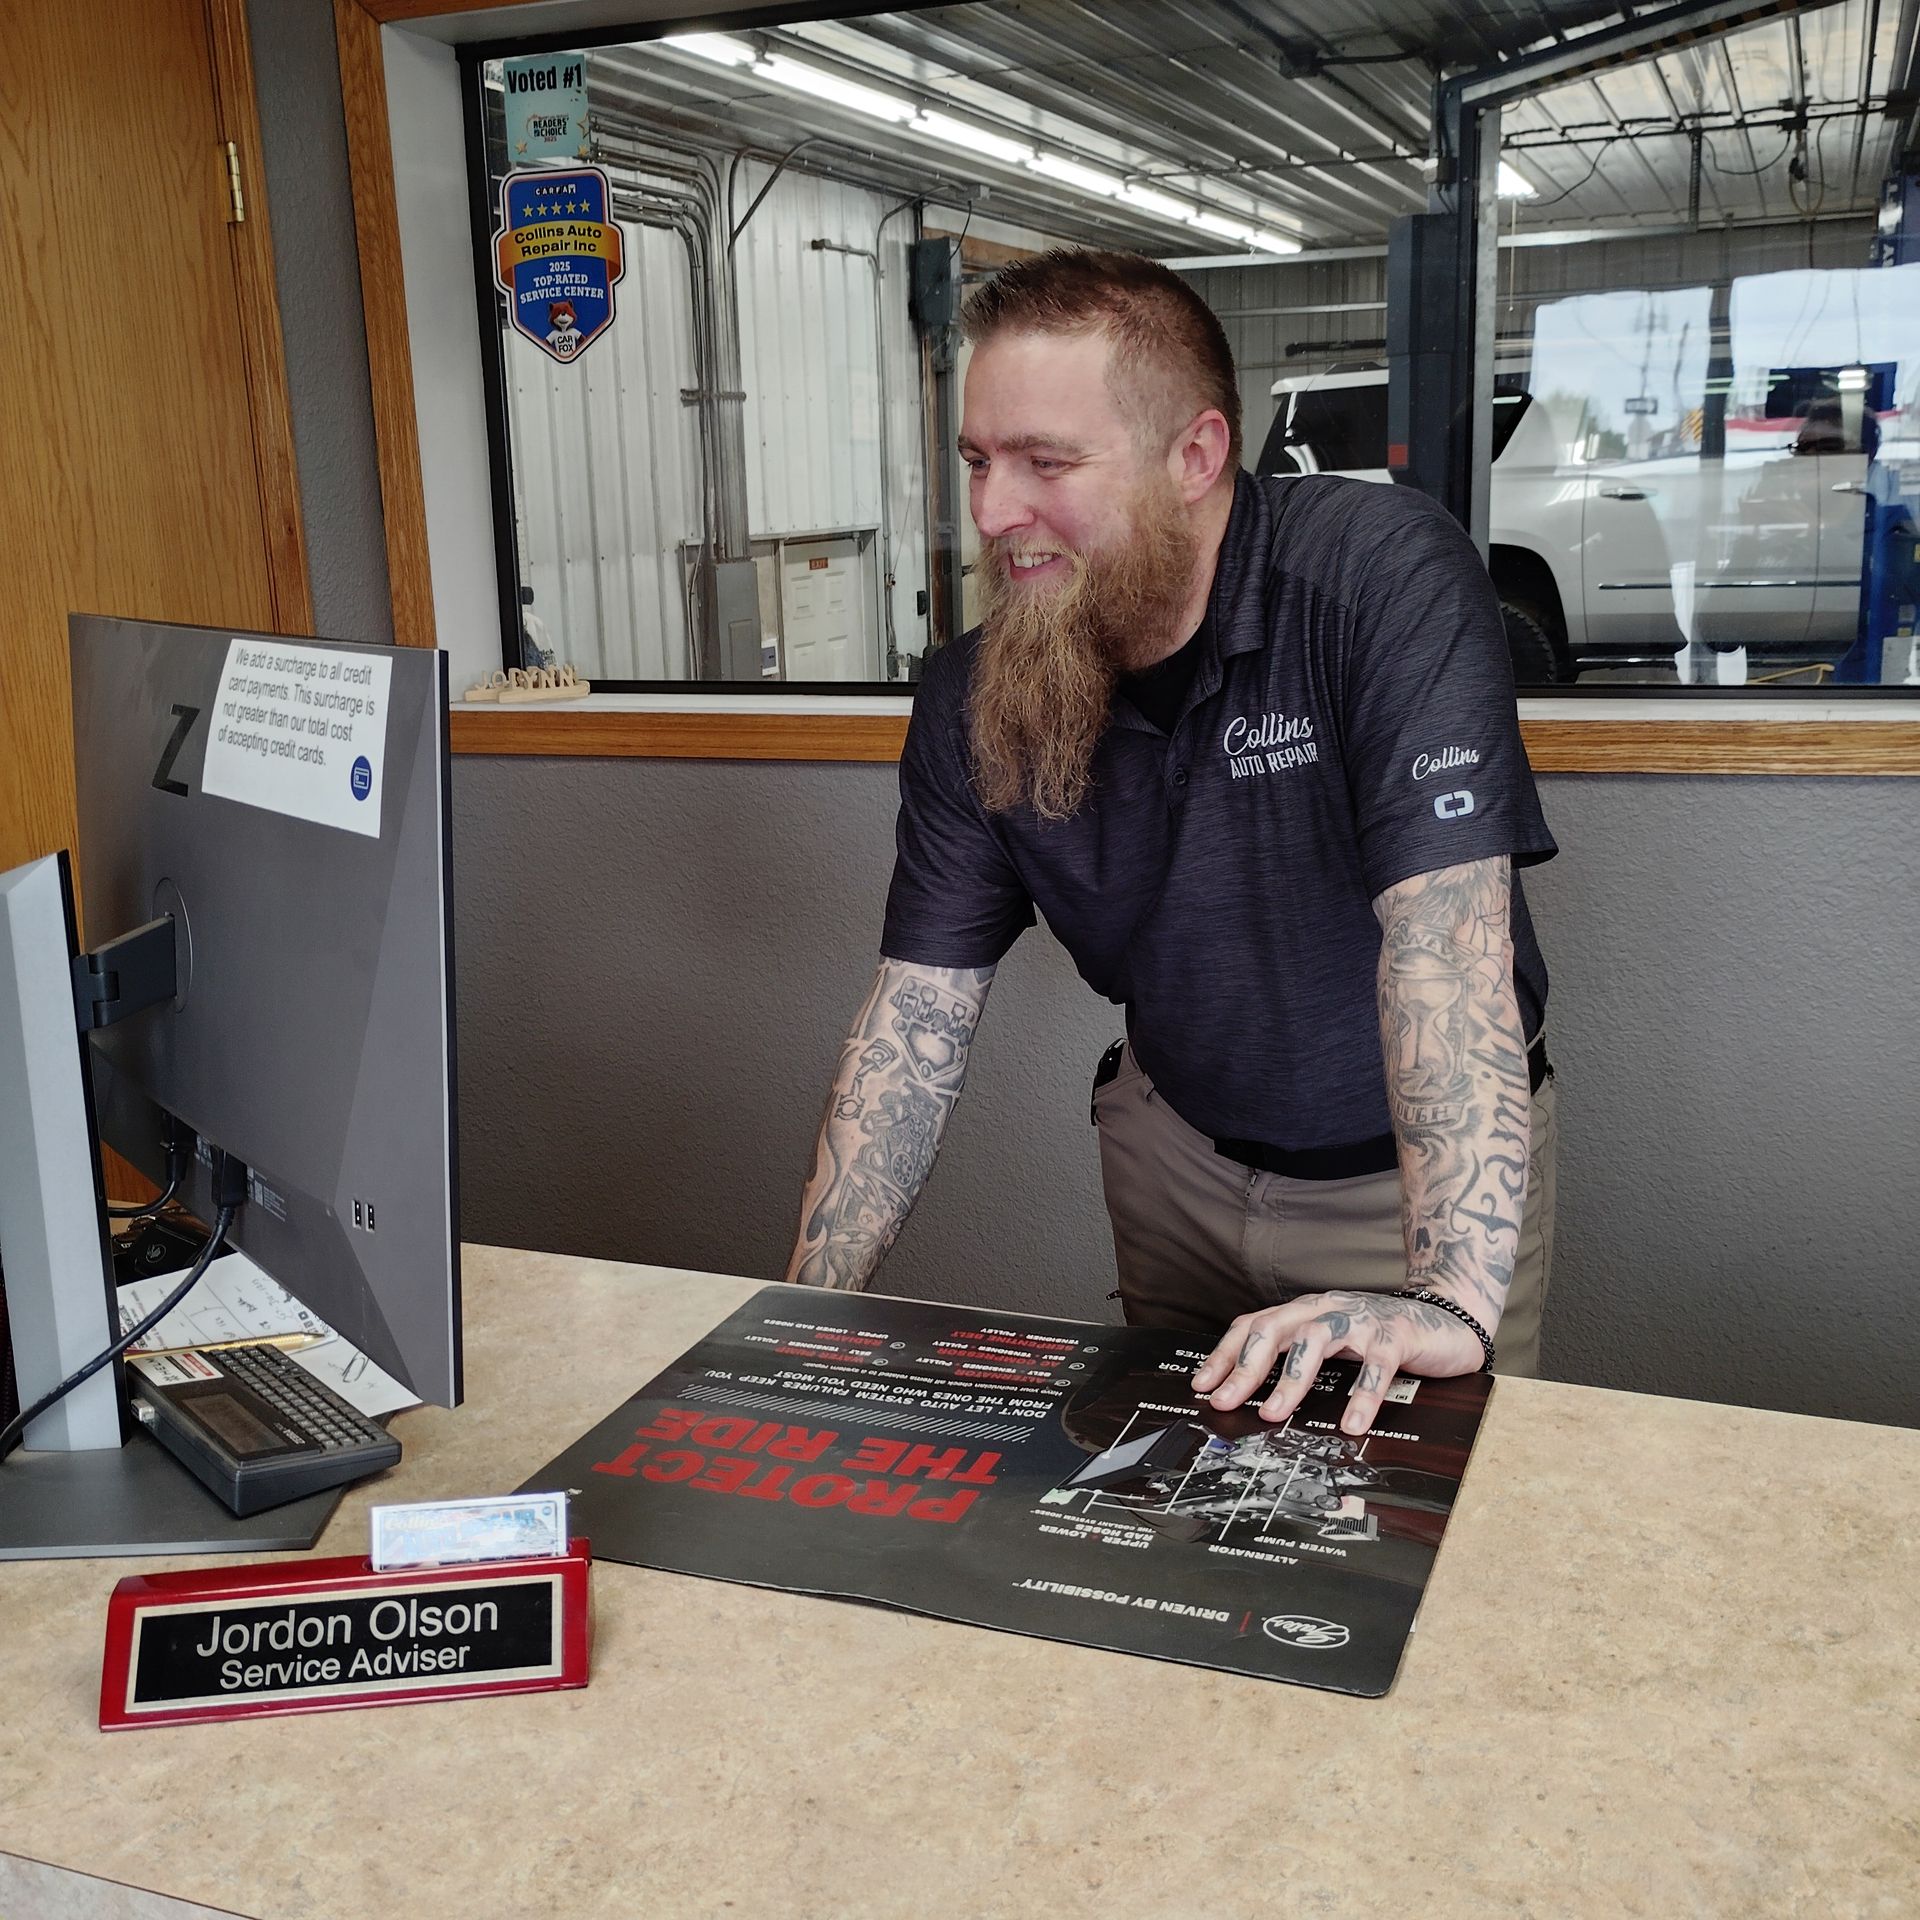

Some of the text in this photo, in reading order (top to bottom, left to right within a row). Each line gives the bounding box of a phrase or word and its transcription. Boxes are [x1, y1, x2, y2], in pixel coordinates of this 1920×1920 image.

[507, 63, 582, 94] Voted #1
[533, 117, 569, 128] READERS'
[540, 126, 567, 137] CHOICE
[515, 225, 602, 244] Collins Auto
[521, 239, 597, 257] Repair Inc
[549, 261, 571, 273] 2025
[520, 286, 604, 304] SERVICE CENTER
[557, 335, 573, 344] CAR
[558, 344, 573, 353] FOX
[236, 648, 372, 685] We add a surcharge to all credit
[228, 675, 248, 693] card
[294, 683, 312, 705] This
[313, 690, 363, 718] surcharge
[366, 695, 375, 716] is
[223, 702, 352, 742] not greater than our total cost
[1223, 712, 1313, 757] Collins
[218, 724, 326, 766] of accepting credit cards.
[1229, 742, 1319, 780] AUTO REPAIR
[1412, 746, 1480, 781] Collins
[763, 1318, 889, 1340] UPPER LOWER RAD HOSES
[980, 1327, 1079, 1345] TENSIONER PULLEY
[744, 1335, 872, 1357] BELT TENSIONER PULLEY
[814, 1332, 883, 1347] RADIATOR
[950, 1331, 1075, 1352] SERPENTINE BELT
[774, 1346, 865, 1364] WATER PUMP
[932, 1340, 1066, 1361] BELT TENSIONER PULLEY
[936, 1348, 1061, 1368] AC COMPRESSOR
[829, 1363, 860, 1374] system
[868, 1369, 877, 1377] to
[878, 1371, 909, 1380] related
[916, 1357, 1052, 1378] BELT TENSIONER PULLEY
[954, 1369, 1048, 1384] ALTERNATOR
[1158, 1362, 1188, 1373] FOR
[910, 1375, 934, 1384] items
[947, 1380, 973, 1389] check
[974, 1383, 1019, 1393] technician
[704, 1369, 1047, 1418] DON'T LET AUTO SYSTEM FAILURES KEEP YOU
[773, 1370, 1054, 1409] FROM THE ONES WHO NEED YOU MOST
[1019, 1386, 1040, 1394] your
[1040, 1389, 1063, 1397] Have
[1137, 1401, 1200, 1416] RADIATOR
[1305, 1420, 1420, 1441] SERPEN BELT
[635, 1406, 1002, 1485] THE RIDE
[591, 1442, 981, 1523] PROTECT
[1063, 1514, 1097, 1525] SYSTEM
[1097, 1520, 1136, 1531] COOLANT
[1039, 1524, 1150, 1549] UPPER LOWER
[1075, 1523, 1154, 1541] RAD HOSES
[1208, 1544, 1299, 1565] ALTERNATOR
[1253, 1535, 1347, 1557] WATER PUMP
[1131, 1597, 1158, 1610] BY
[1159, 1599, 1231, 1622] DRIVEN
[196, 1598, 498, 1658] Jordon Olson
[219, 1643, 470, 1690] Service Adviser
